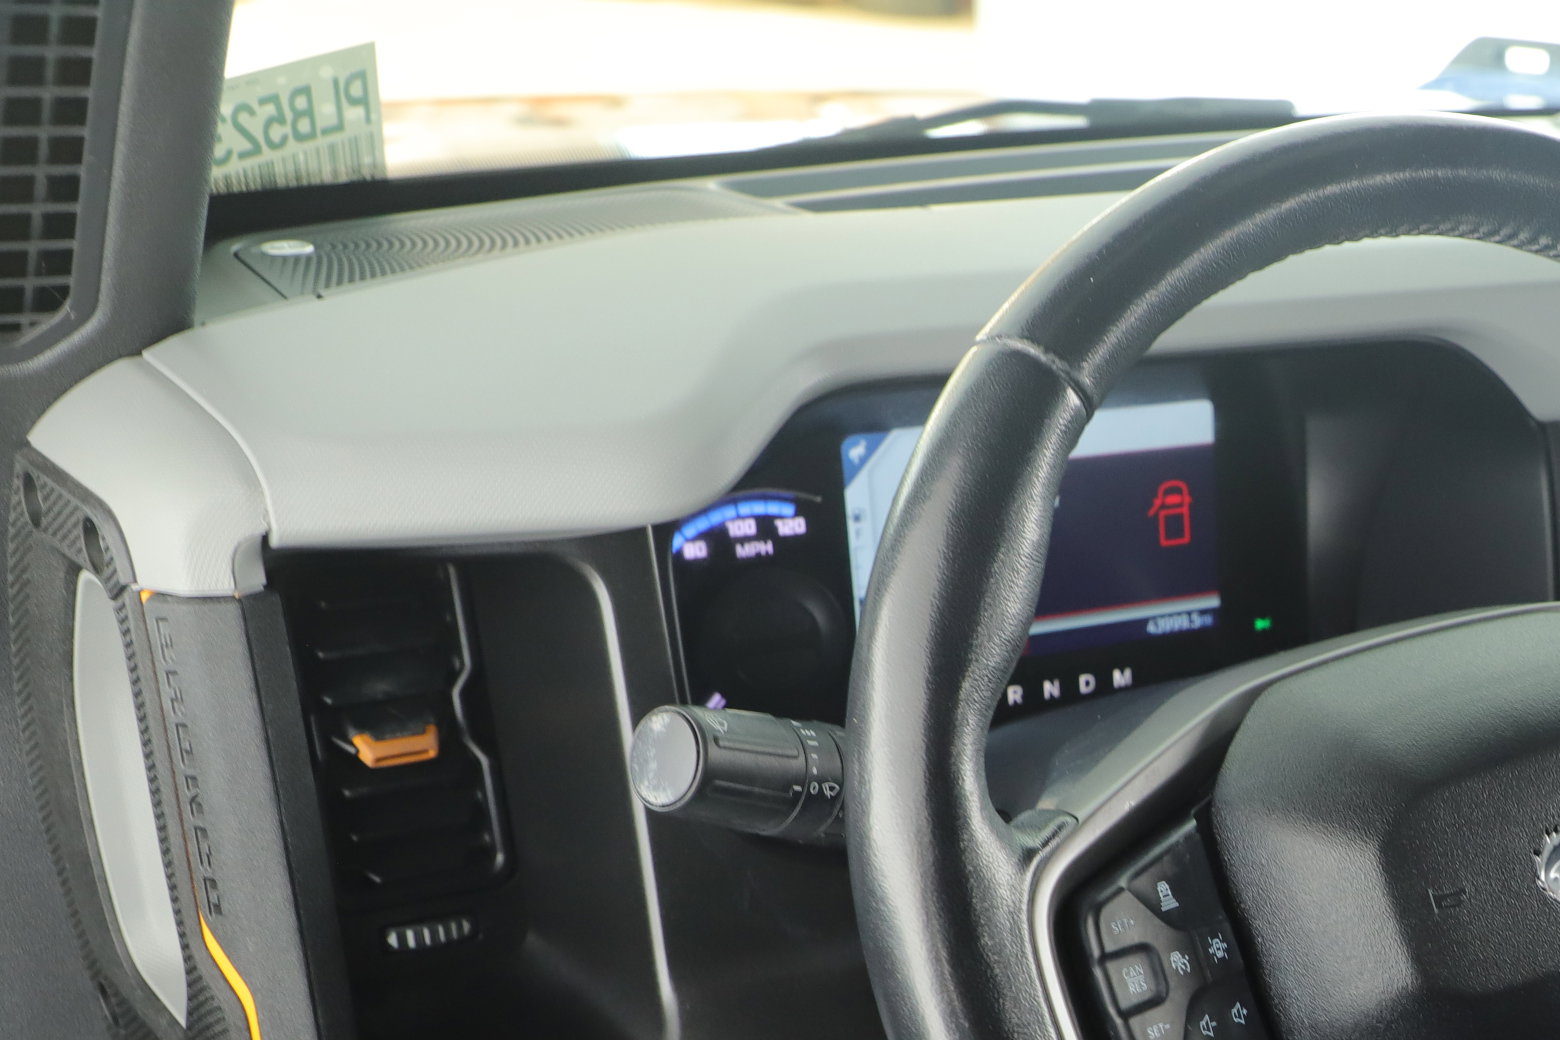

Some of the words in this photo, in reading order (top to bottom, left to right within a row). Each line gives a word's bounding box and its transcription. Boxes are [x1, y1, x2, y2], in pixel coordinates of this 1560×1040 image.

[725, 517, 757, 538] 100
[774, 516, 806, 537] 120
[682, 540, 707, 560] 80
[735, 539, 774, 559] MPH
[1007, 685, 1024, 706] R
[1043, 678, 1060, 700] N
[1079, 674, 1096, 694] D
[1112, 667, 1132, 688] M
[1121, 963, 1144, 979] CAN
[1128, 978, 1148, 995] RES
